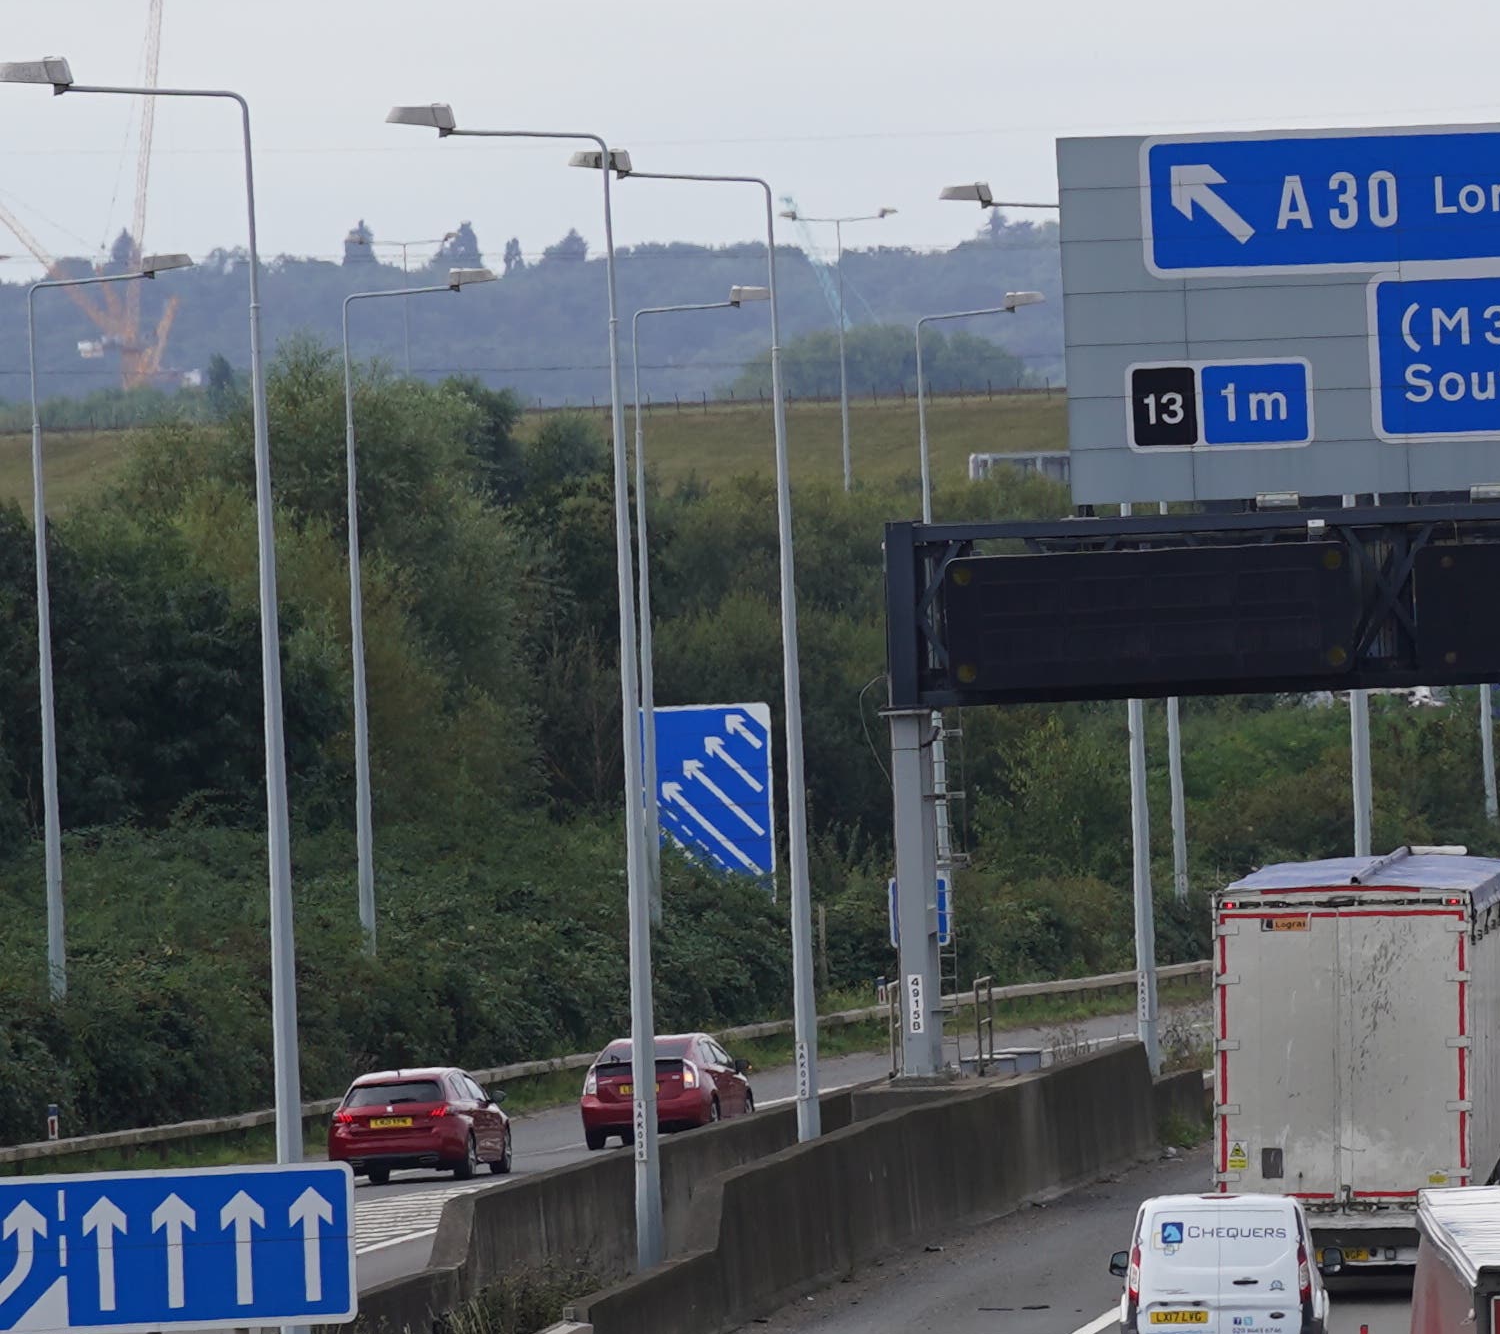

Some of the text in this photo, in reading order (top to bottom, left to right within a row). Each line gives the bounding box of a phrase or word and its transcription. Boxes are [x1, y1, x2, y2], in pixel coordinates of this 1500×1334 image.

[1276, 169, 1399, 231] A30
[1142, 391, 1185, 426] 13
[1156, 1312, 1180, 1322] LX17
